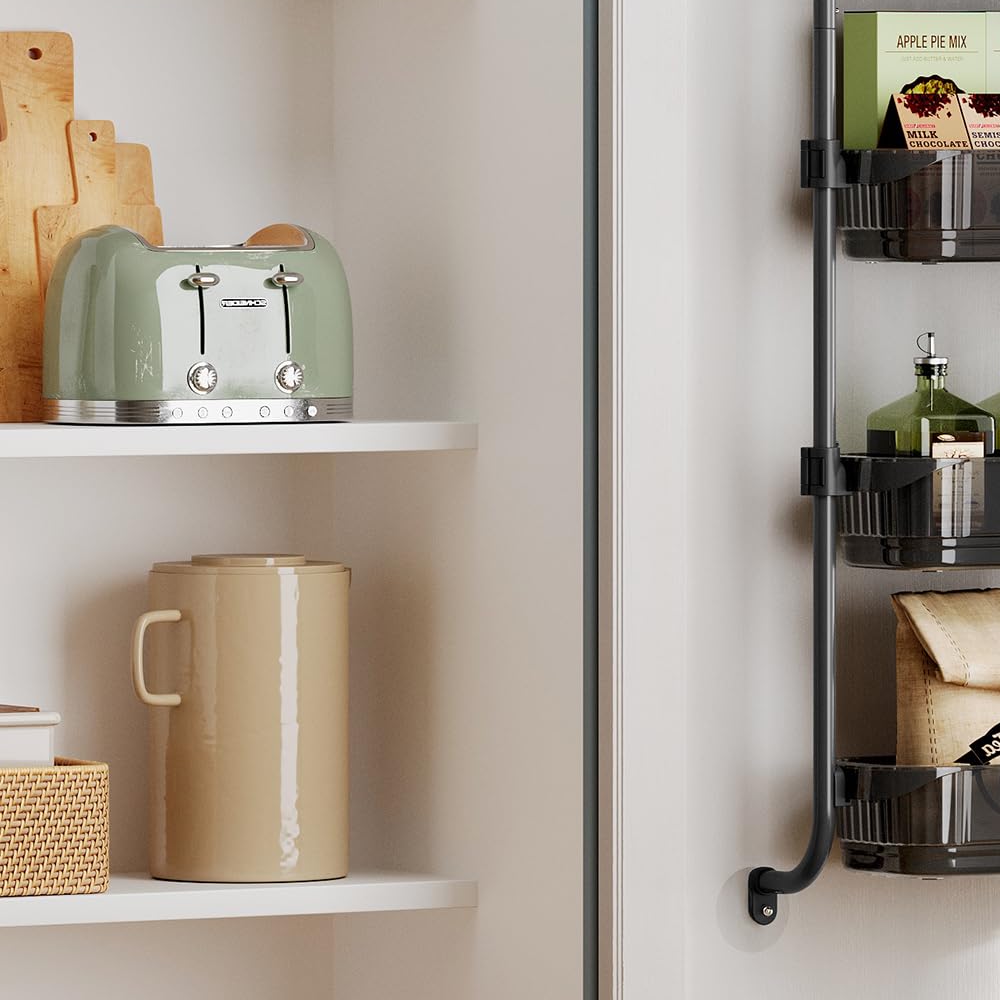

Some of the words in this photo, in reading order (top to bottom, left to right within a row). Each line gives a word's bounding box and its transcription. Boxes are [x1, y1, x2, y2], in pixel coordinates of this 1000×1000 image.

[896, 34, 928, 49] APPLE
[930, 34, 946, 49] PIE
[948, 34, 968, 49] MIX
[906, 130, 939, 139] MILK
[909, 140, 969, 148] CHOCOLATE
